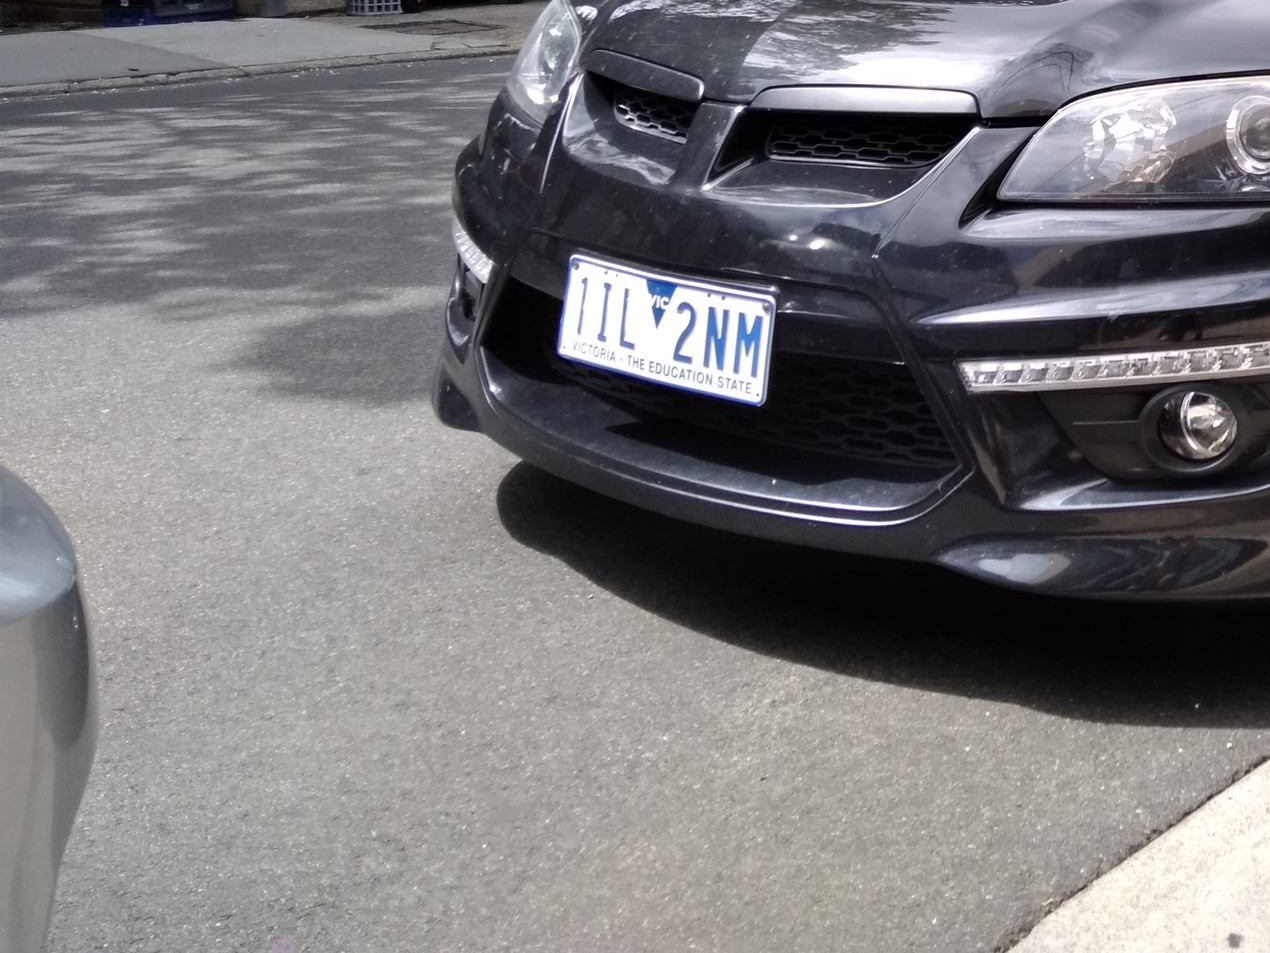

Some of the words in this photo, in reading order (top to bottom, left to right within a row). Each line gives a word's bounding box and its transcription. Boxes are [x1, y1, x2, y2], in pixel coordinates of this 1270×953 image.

[649, 294, 670, 310] VIC
[572, 340, 616, 362] VICTORIA
[627, 354, 645, 371] THE
[649, 361, 713, 386] EDUCATION
[717, 376, 752, 395] STATE
[672, 301, 764, 379] 2NM
